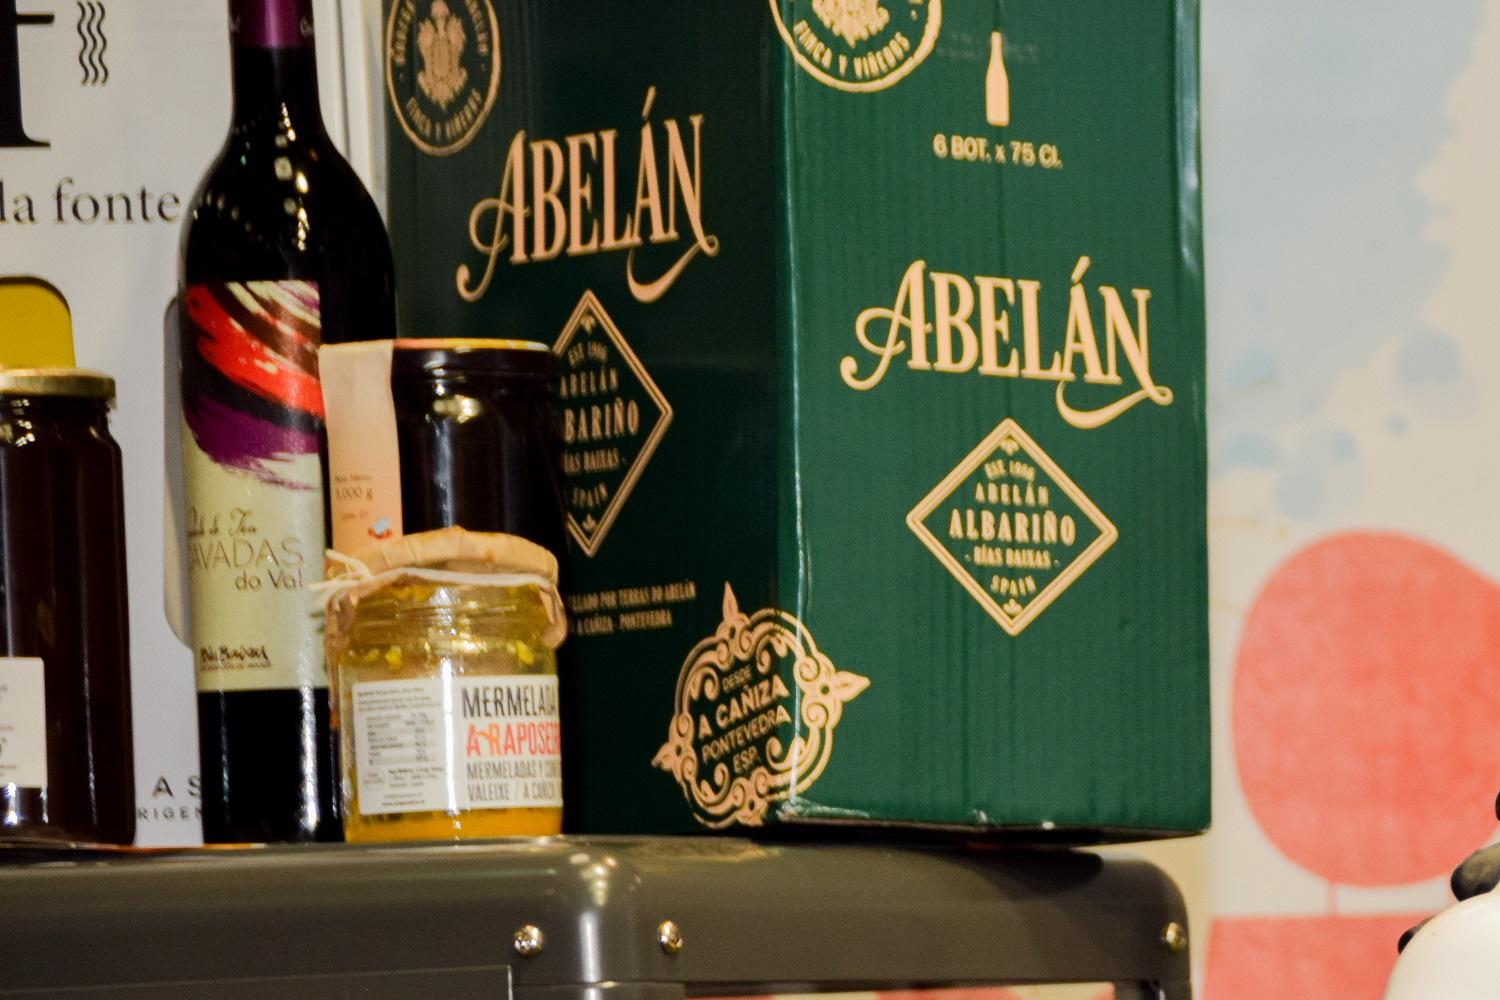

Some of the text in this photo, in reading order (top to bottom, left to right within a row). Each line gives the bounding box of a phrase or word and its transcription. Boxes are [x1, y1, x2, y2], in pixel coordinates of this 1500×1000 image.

[838, 53, 848, 77] Y
[933, 133, 948, 159] 6
[950, 134, 992, 164] BOT.
[1010, 140, 1036, 167] 75
[51, 176, 181, 225] fonte
[456, 85, 720, 304] ABELÁN
[840, 256, 1173, 428] ABELÁN
[563, 398, 640, 445] BARIÑO
[975, 480, 1049, 507] ABELÁN
[949, 508, 1076, 546] ALBARIÑO
[990, 574, 1037, 598] SPAIN
[699, 674, 790, 740] A CAÑIZA
[702, 704, 792, 765] PONTEVEDRA
[137, 806, 202, 821] RIGEN
